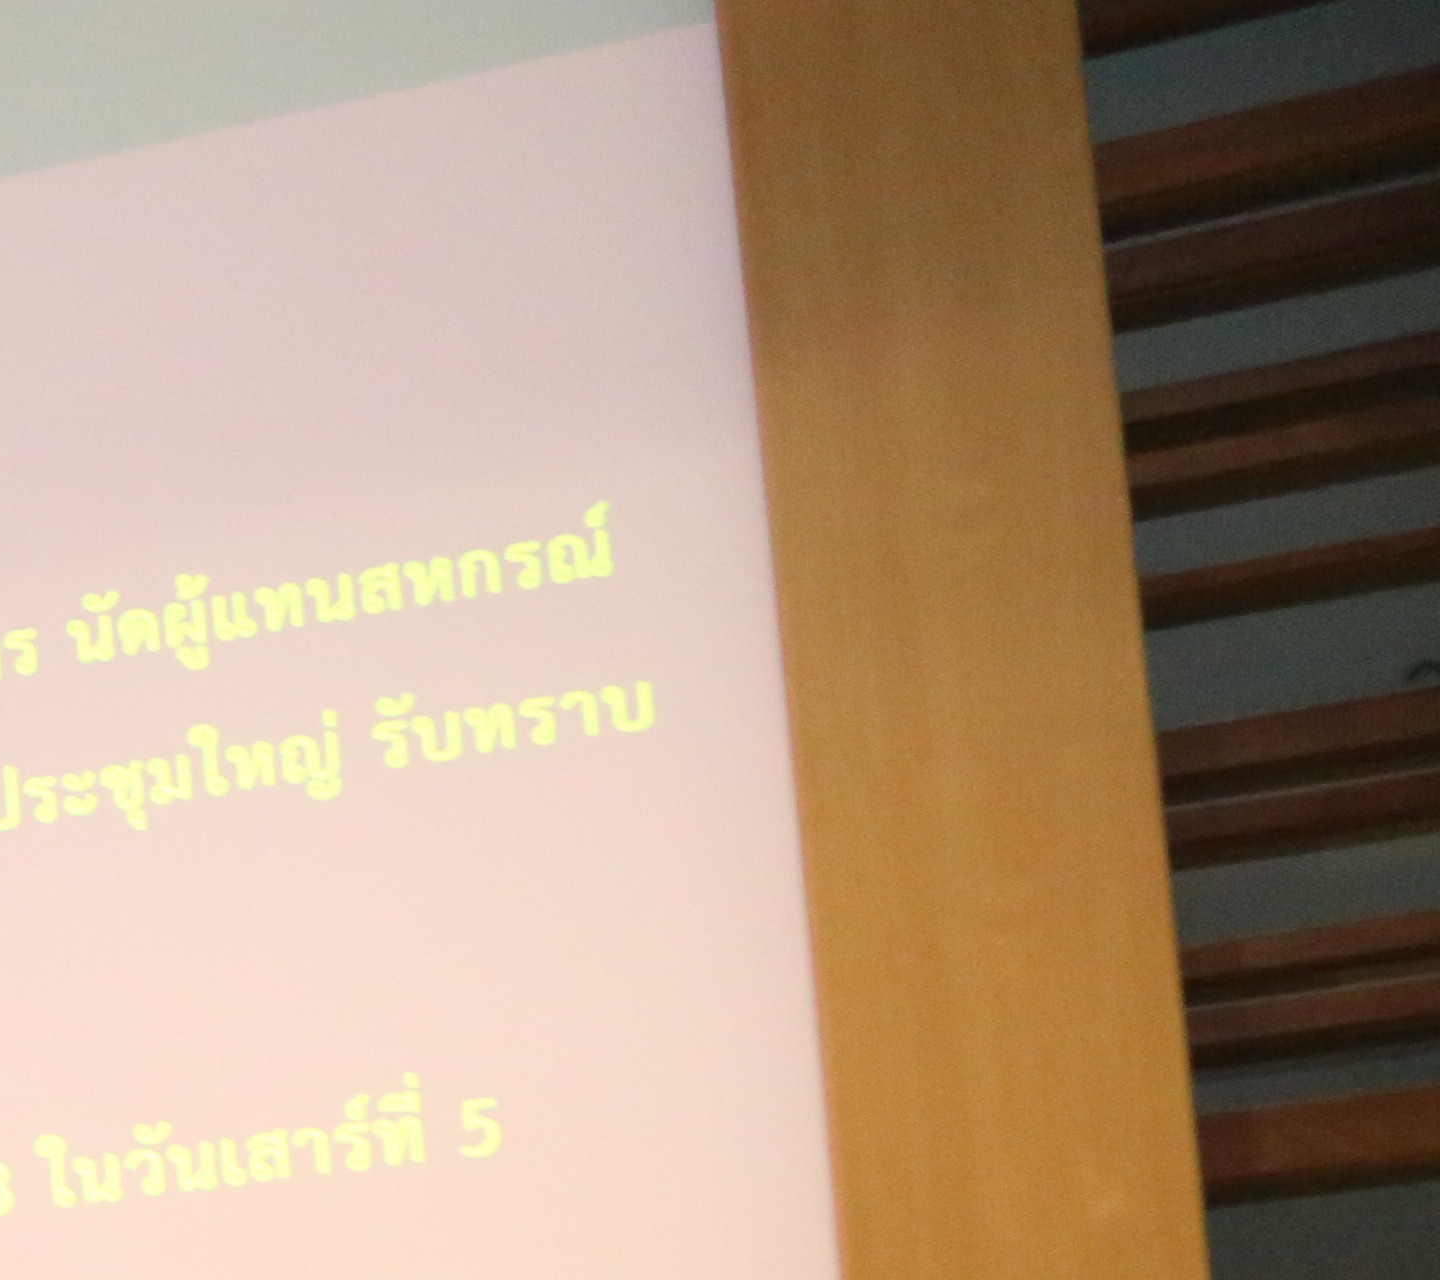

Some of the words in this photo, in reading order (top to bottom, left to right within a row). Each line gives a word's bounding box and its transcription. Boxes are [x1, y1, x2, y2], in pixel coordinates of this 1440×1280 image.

[67, 501, 614, 670] นัดผู้แทนสหกรณ์
[372, 681, 655, 768] รับทราบ
[36, 1074, 425, 1207] ในวันเสาร์ที่
[461, 1097, 503, 1157] 5
